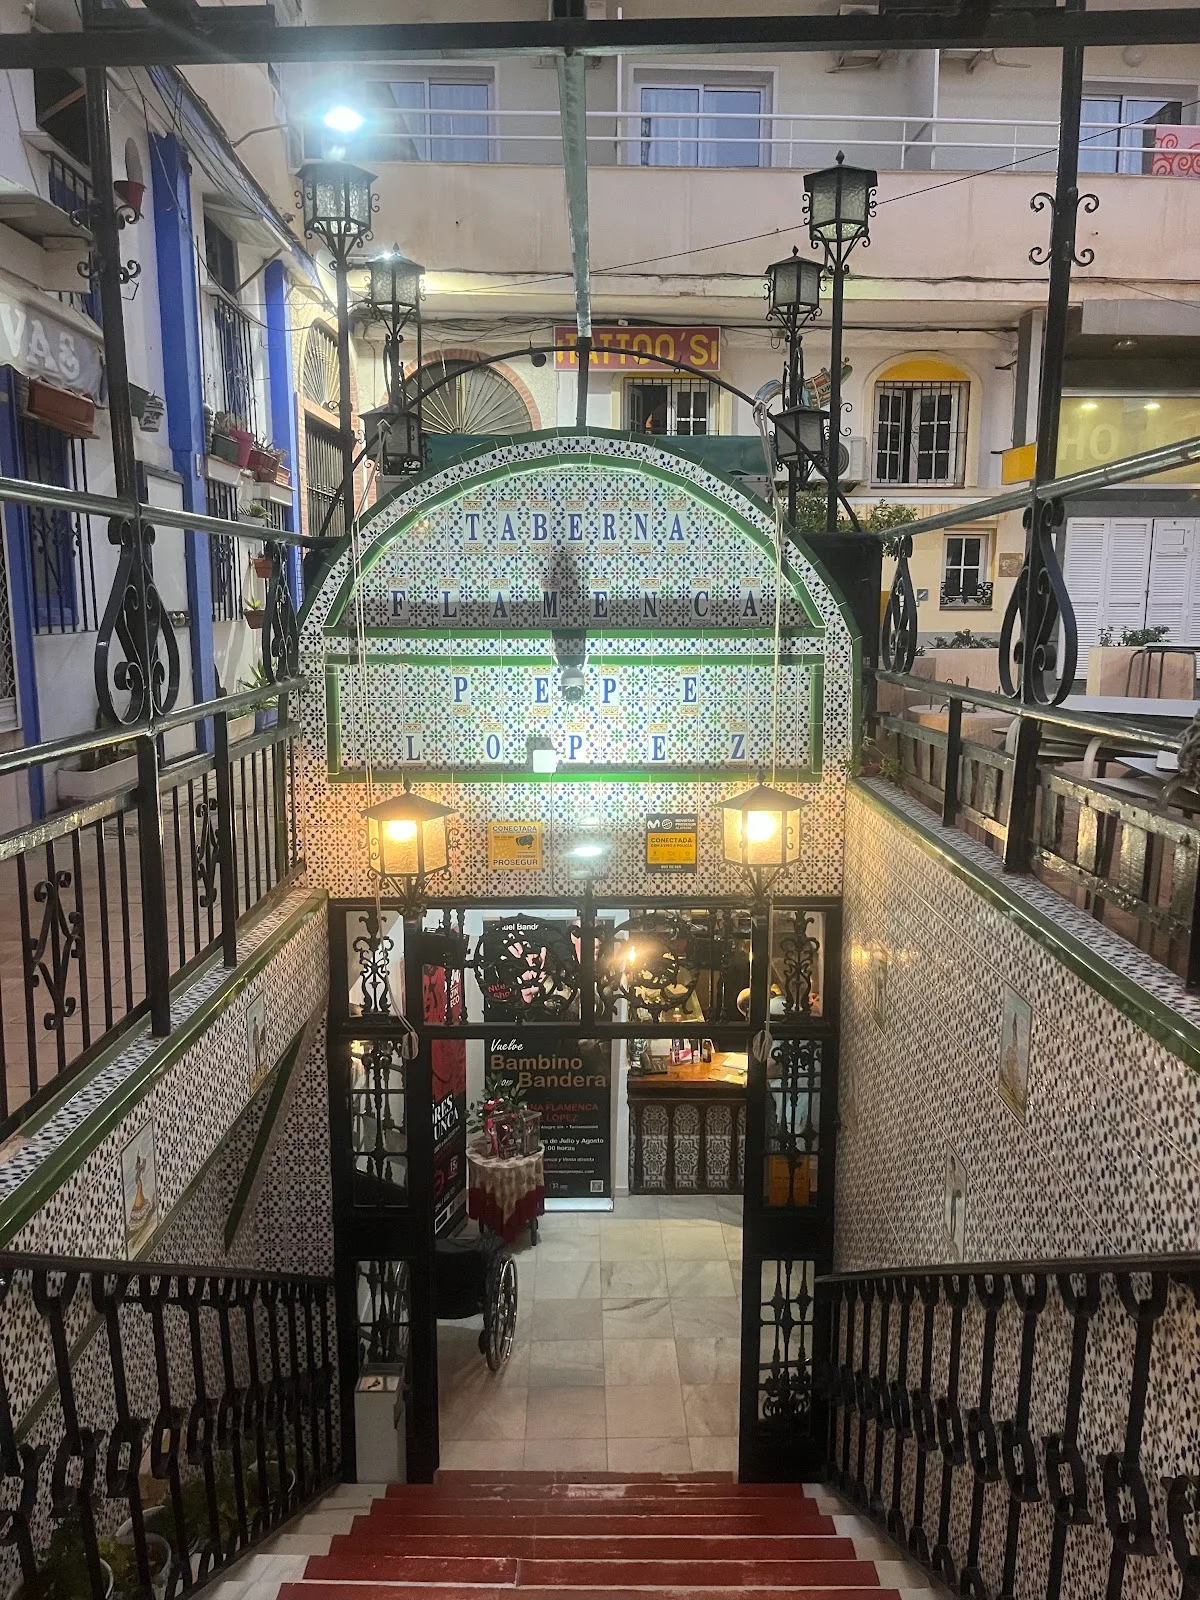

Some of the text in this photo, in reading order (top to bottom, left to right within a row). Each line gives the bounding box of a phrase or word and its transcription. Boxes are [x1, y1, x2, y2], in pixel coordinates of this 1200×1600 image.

[463, 513, 686, 542] TABERNA
[390, 590, 760, 619] FLAMENCA
[454, 676, 698, 704] PEPE
[405, 733, 746, 761] LOPEZ
[490, 1038, 524, 1053] Vuelve
[490, 1054, 583, 1070] Bambino
[519, 1072, 606, 1088] Bandera
[546, 1103, 599, 1111] FLAMENCA
